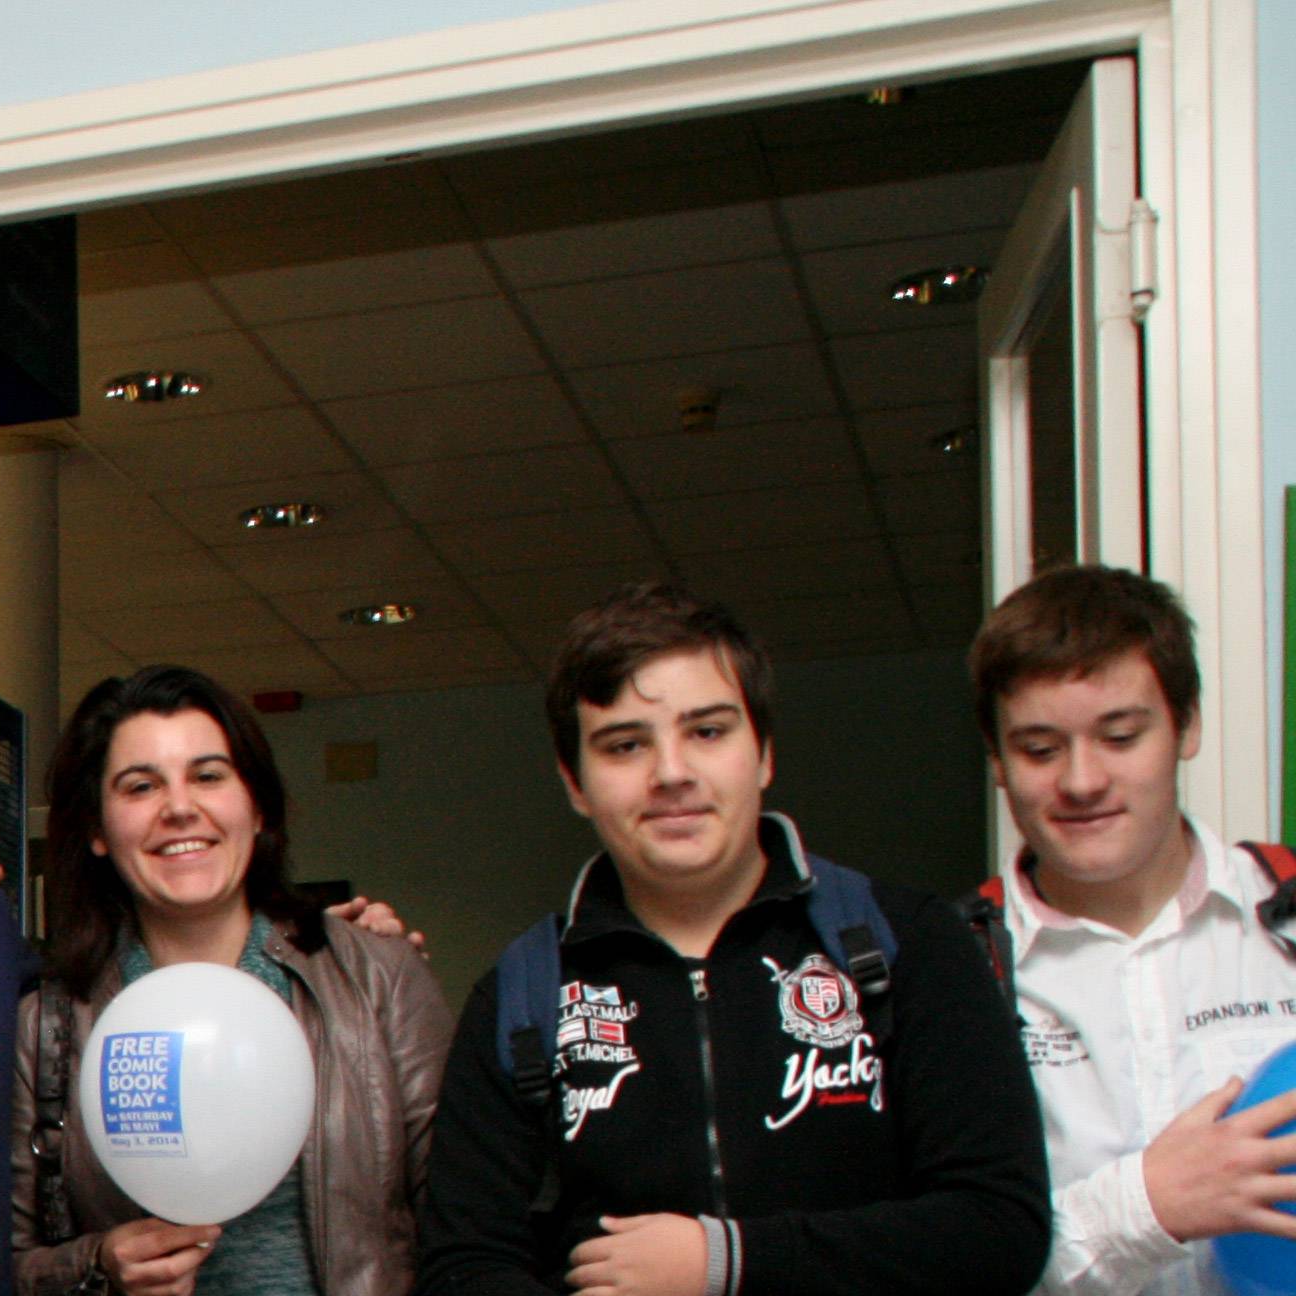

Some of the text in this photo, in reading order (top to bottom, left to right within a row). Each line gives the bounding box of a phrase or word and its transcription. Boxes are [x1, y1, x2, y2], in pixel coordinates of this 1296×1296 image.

[1185, 1000, 1270, 1032] EXPANSION
[110, 1036, 169, 1058] FREE
[108, 1056, 169, 1075] COMIC
[108, 1073, 168, 1093] BOOK
[118, 1092, 157, 1109] DAY
